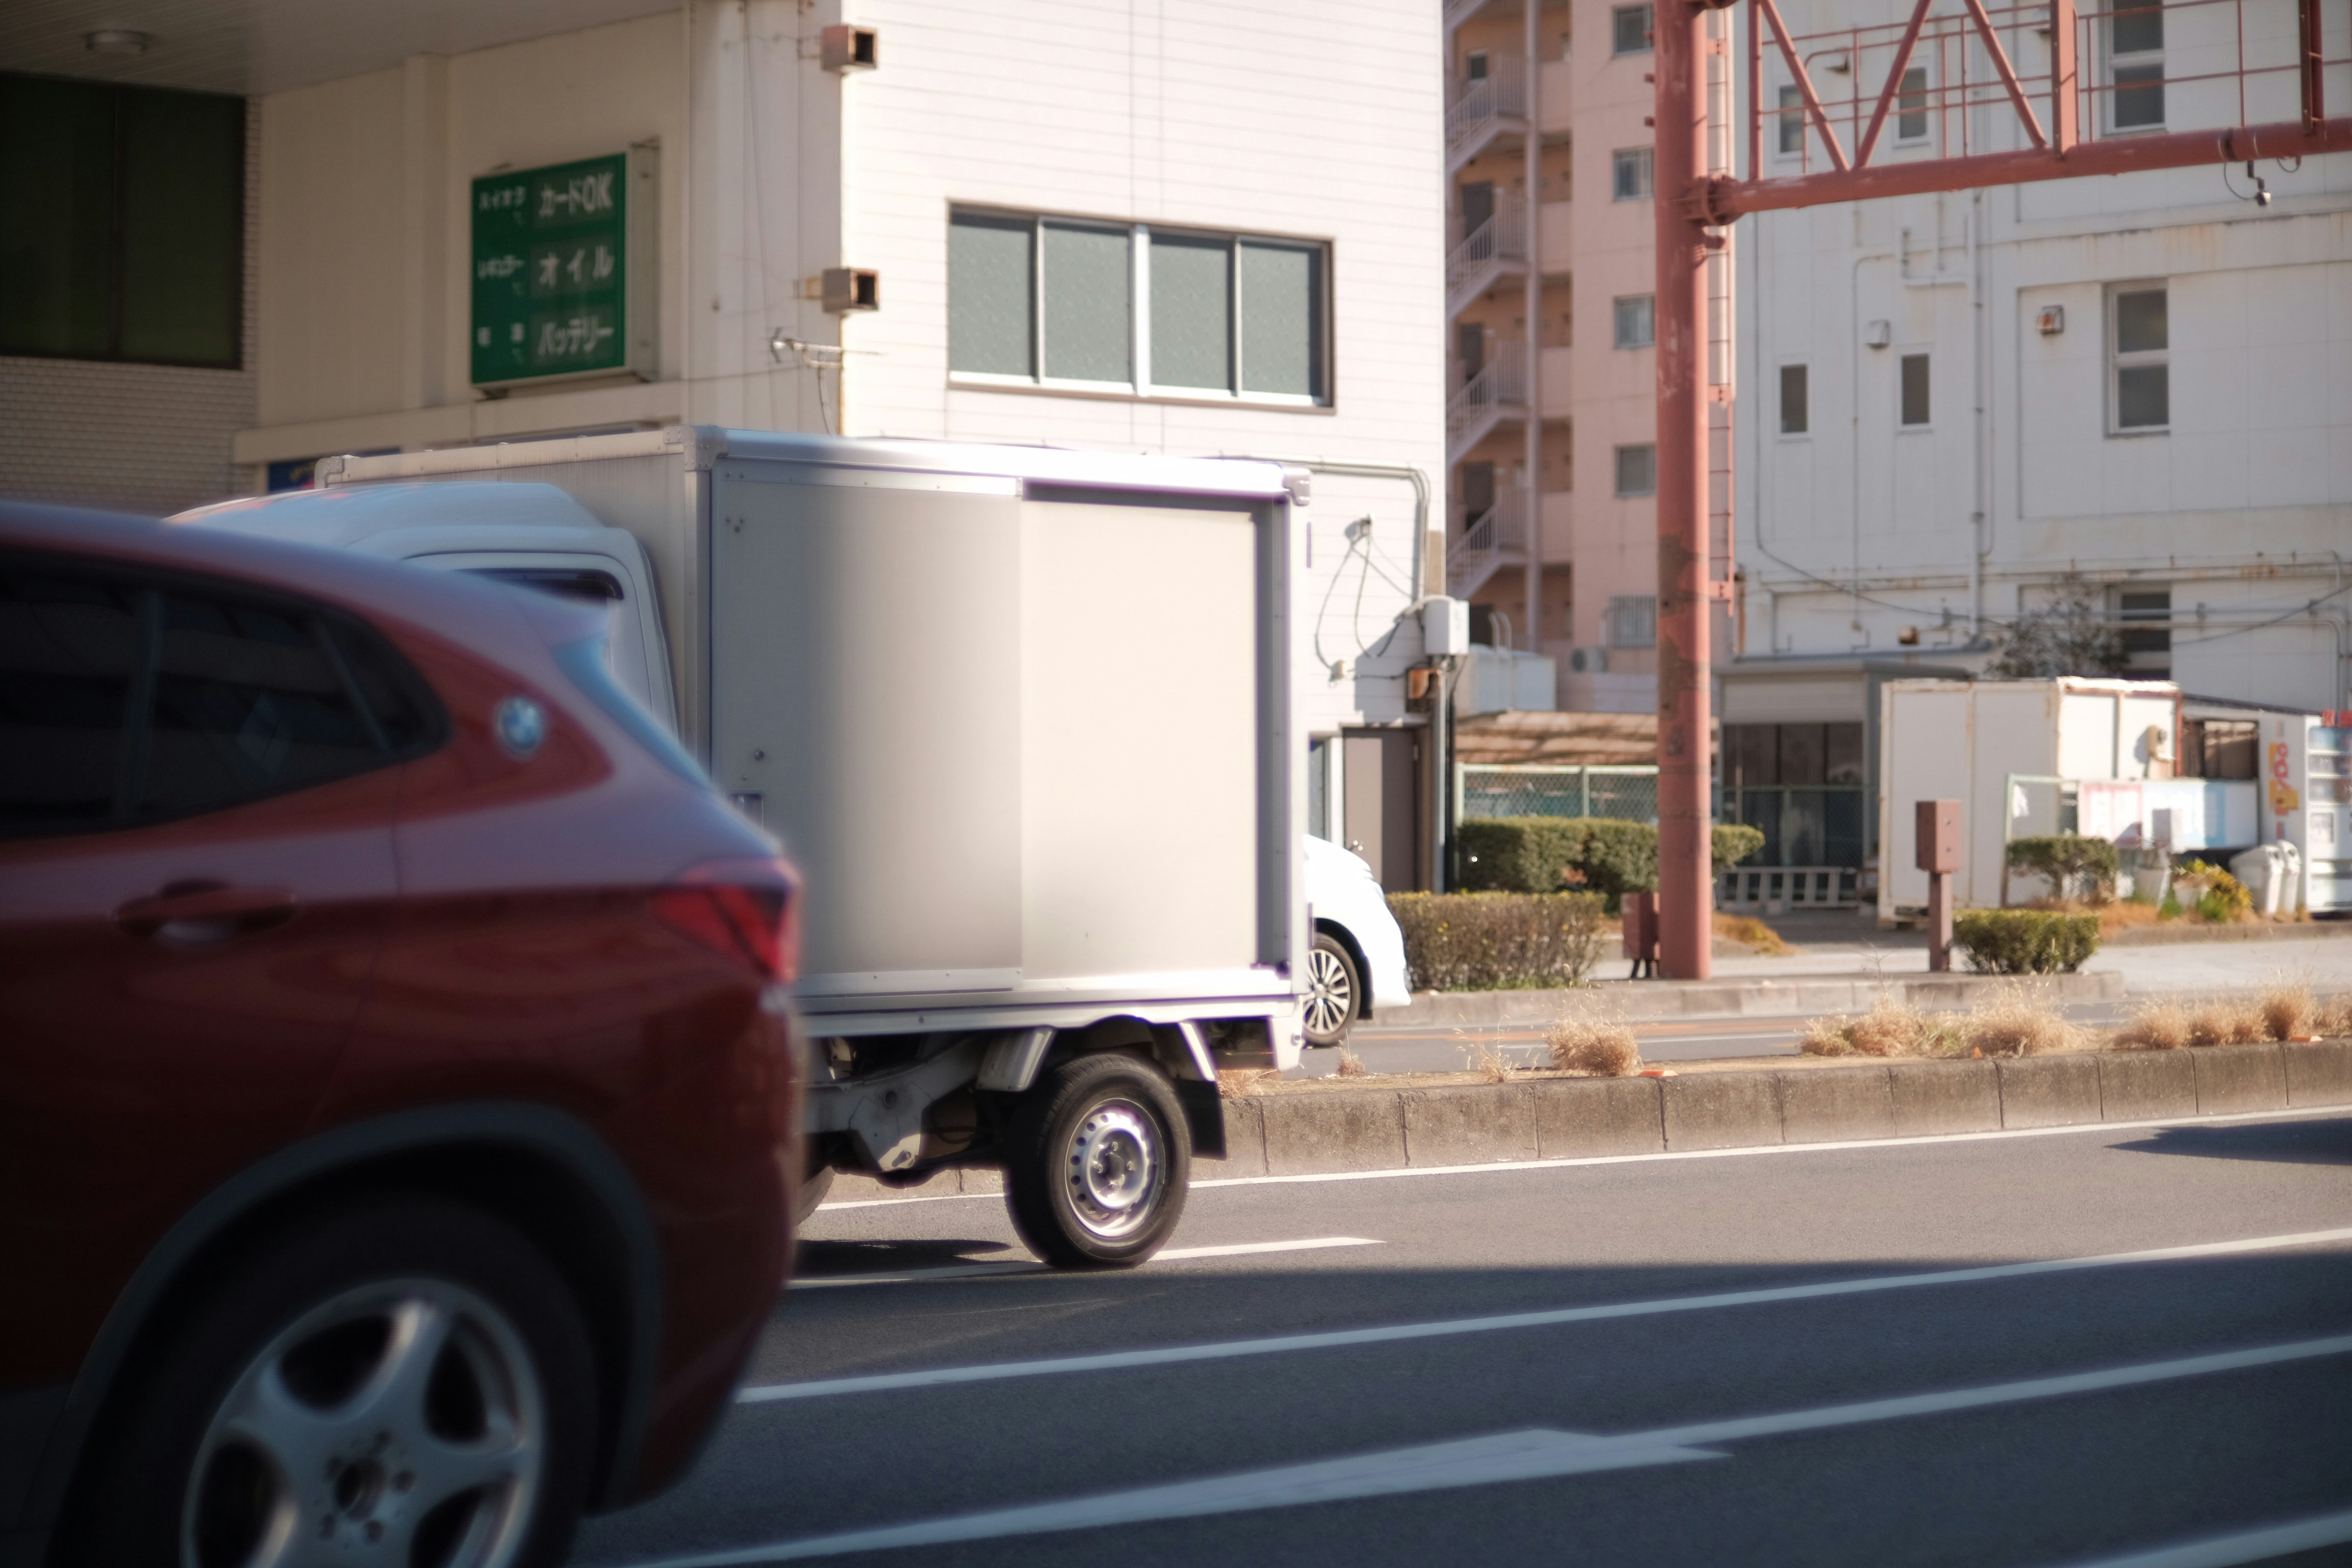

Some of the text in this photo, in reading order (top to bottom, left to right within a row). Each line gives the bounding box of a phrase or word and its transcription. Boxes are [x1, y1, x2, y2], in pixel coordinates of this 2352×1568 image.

[538, 172, 613, 217] カードOK
[538, 246, 614, 289] オイル
[537, 315, 615, 356] バッテリー
